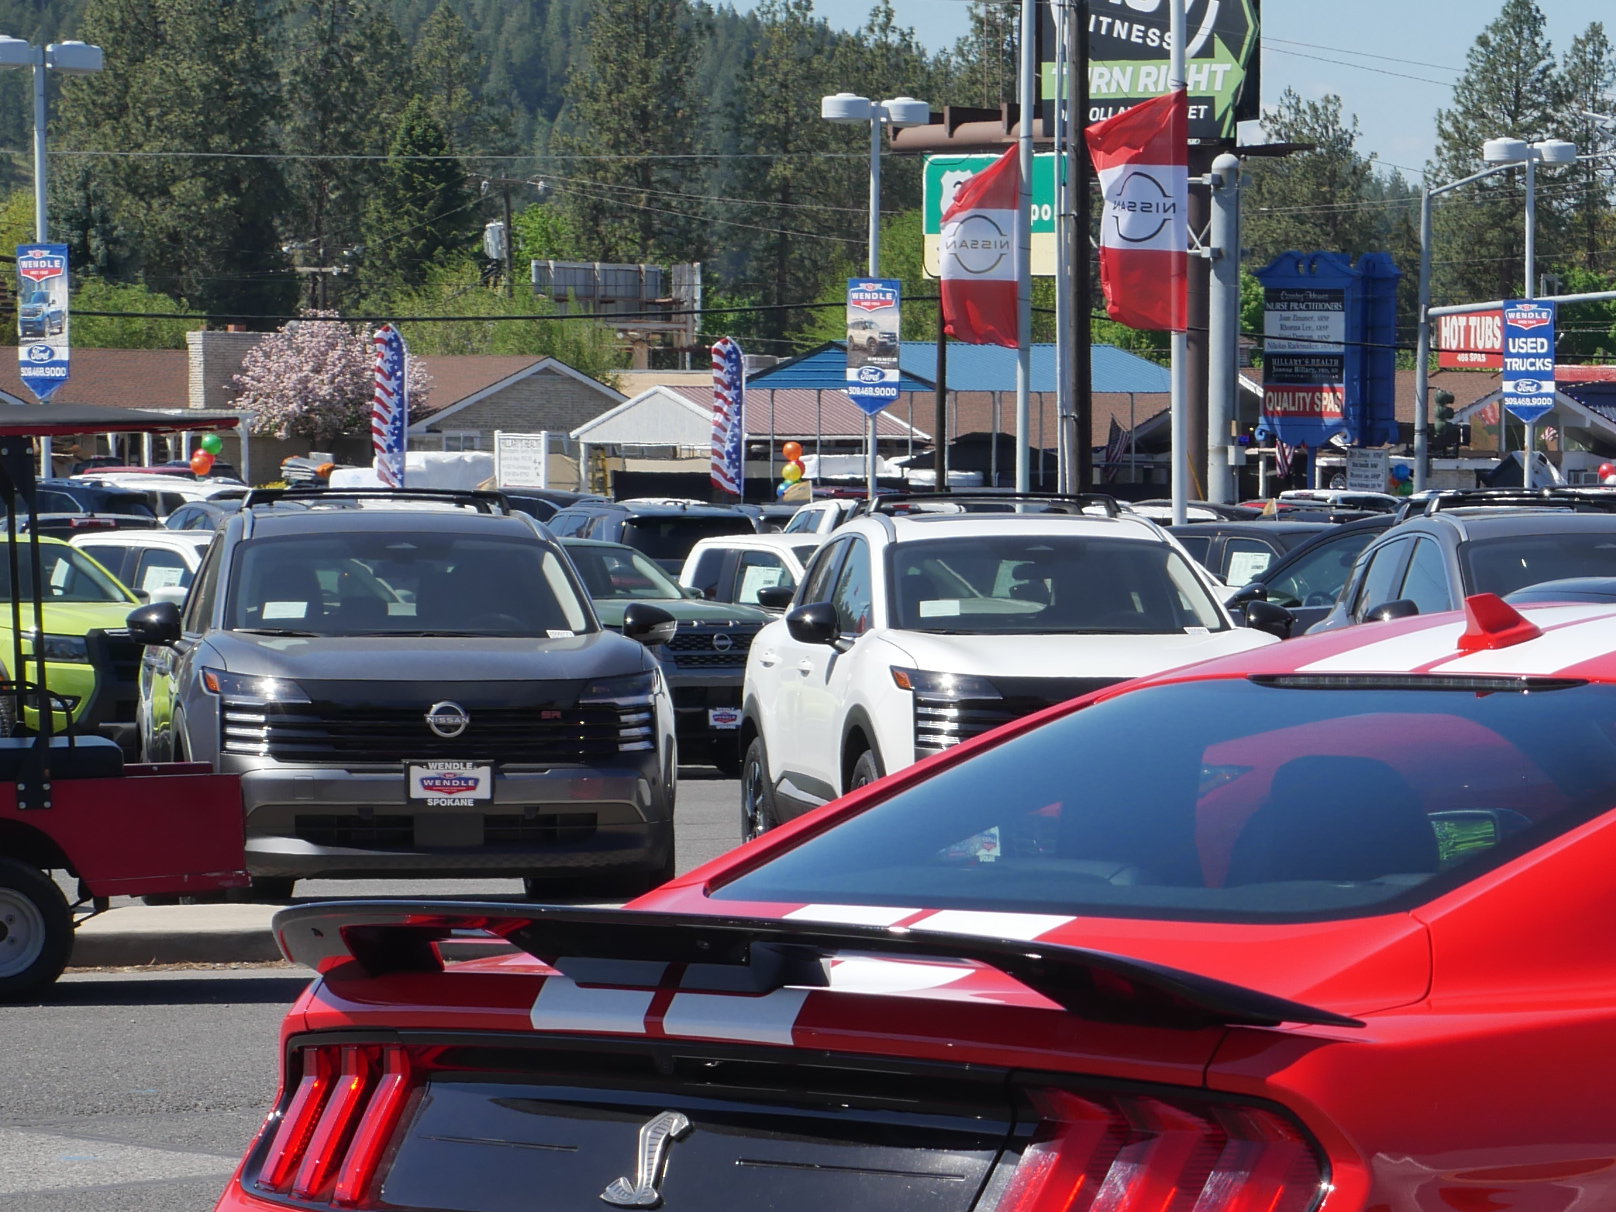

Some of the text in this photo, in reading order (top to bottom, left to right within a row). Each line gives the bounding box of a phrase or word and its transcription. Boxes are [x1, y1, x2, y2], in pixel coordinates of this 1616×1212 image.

[1088, 14, 1172, 50] ITNESS
[21, 260, 61, 268] WENDLE
[852, 292, 893, 300] WENDLE
[1266, 302, 1342, 311] NURSE PRACTITIONERS
[1508, 311, 1547, 319] WENDLE
[1441, 315, 1501, 349] HOT TUBS
[1509, 337, 1548, 353] USED
[1504, 357, 1552, 371] TRUCKS
[1517, 380, 1537, 392] Ford
[1266, 391, 1342, 412] QUALITY SPAS
[1504, 397, 1553, 406] 509.468.9000
[541, 710, 561, 719] SR
[426, 716, 470, 725] NISSAN
[428, 762, 473, 771] WENDLE
[423, 779, 476, 787] WENDLE
[427, 798, 475, 807] SPOKANE
